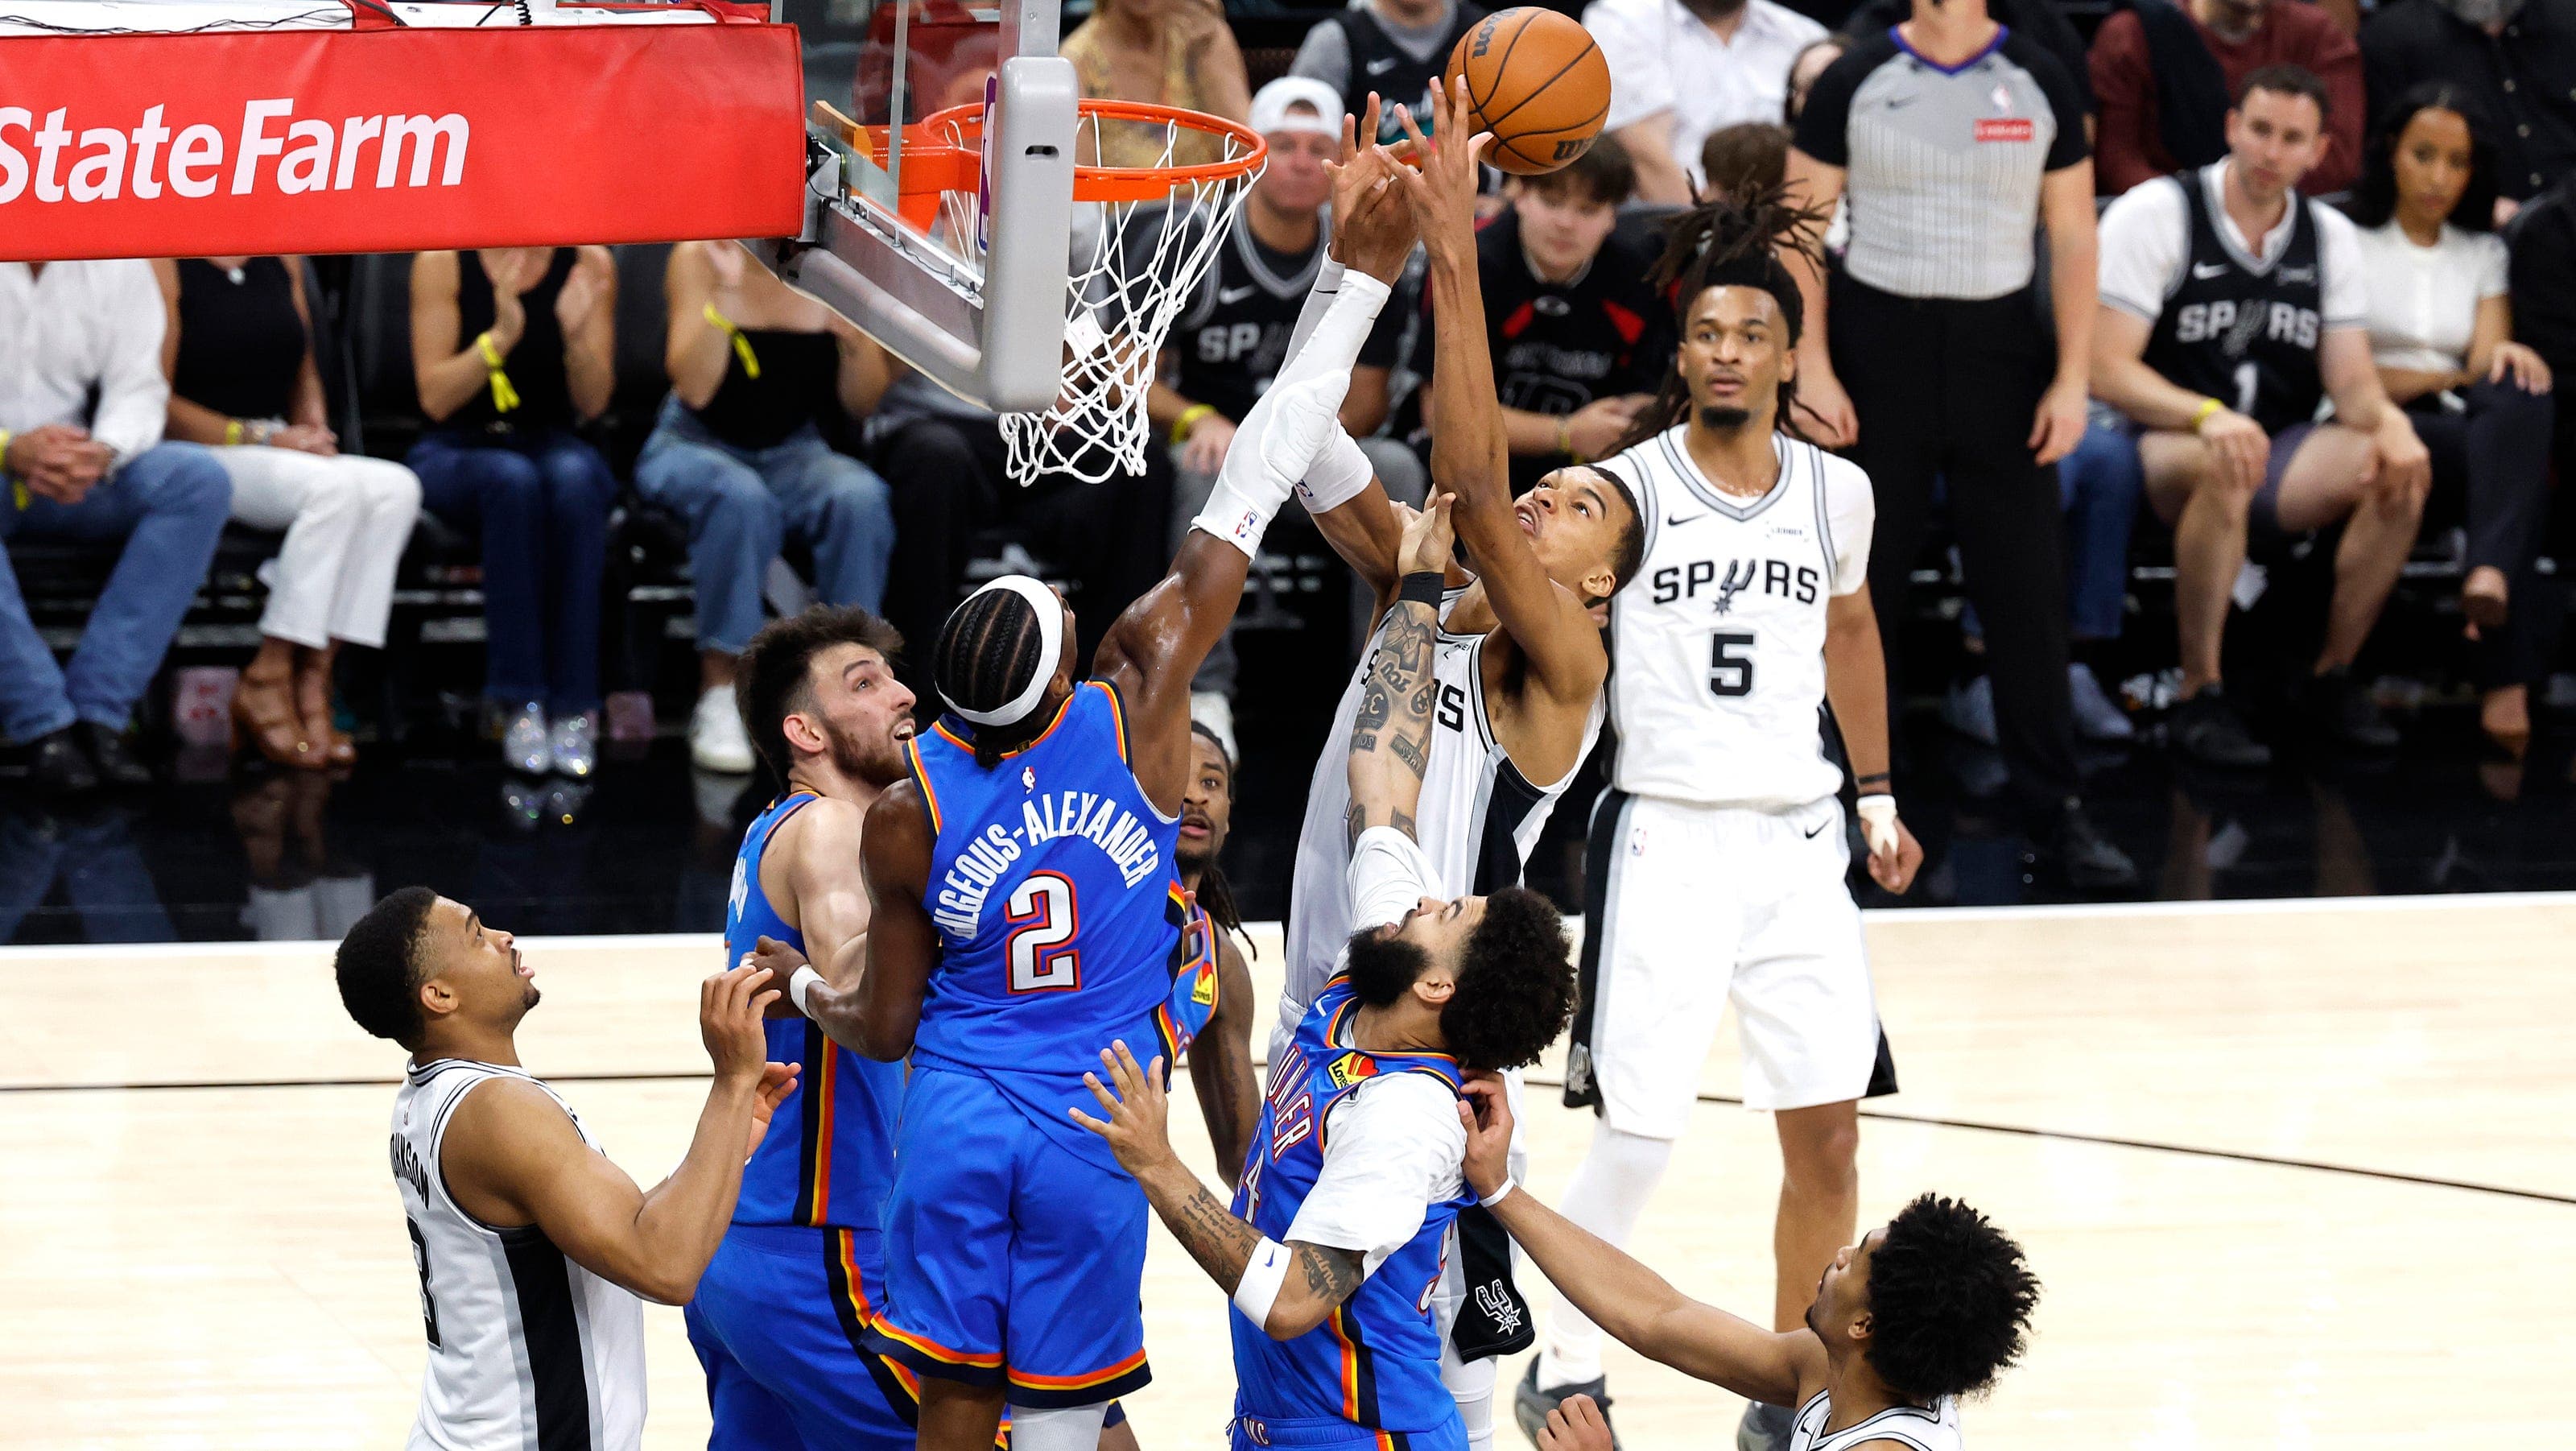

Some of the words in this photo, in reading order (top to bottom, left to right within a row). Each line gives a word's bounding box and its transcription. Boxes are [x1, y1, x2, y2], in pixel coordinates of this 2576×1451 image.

[230, 97, 470, 196] Farm
[2176, 299, 2319, 358] SPURS
[1653, 559, 1819, 617] SPURS
[1707, 627, 1758, 699] 5
[1004, 869, 1082, 995] 2
[1266, 1044, 1314, 1164] UNDER
[390, 1132, 430, 1210] OHNSON
